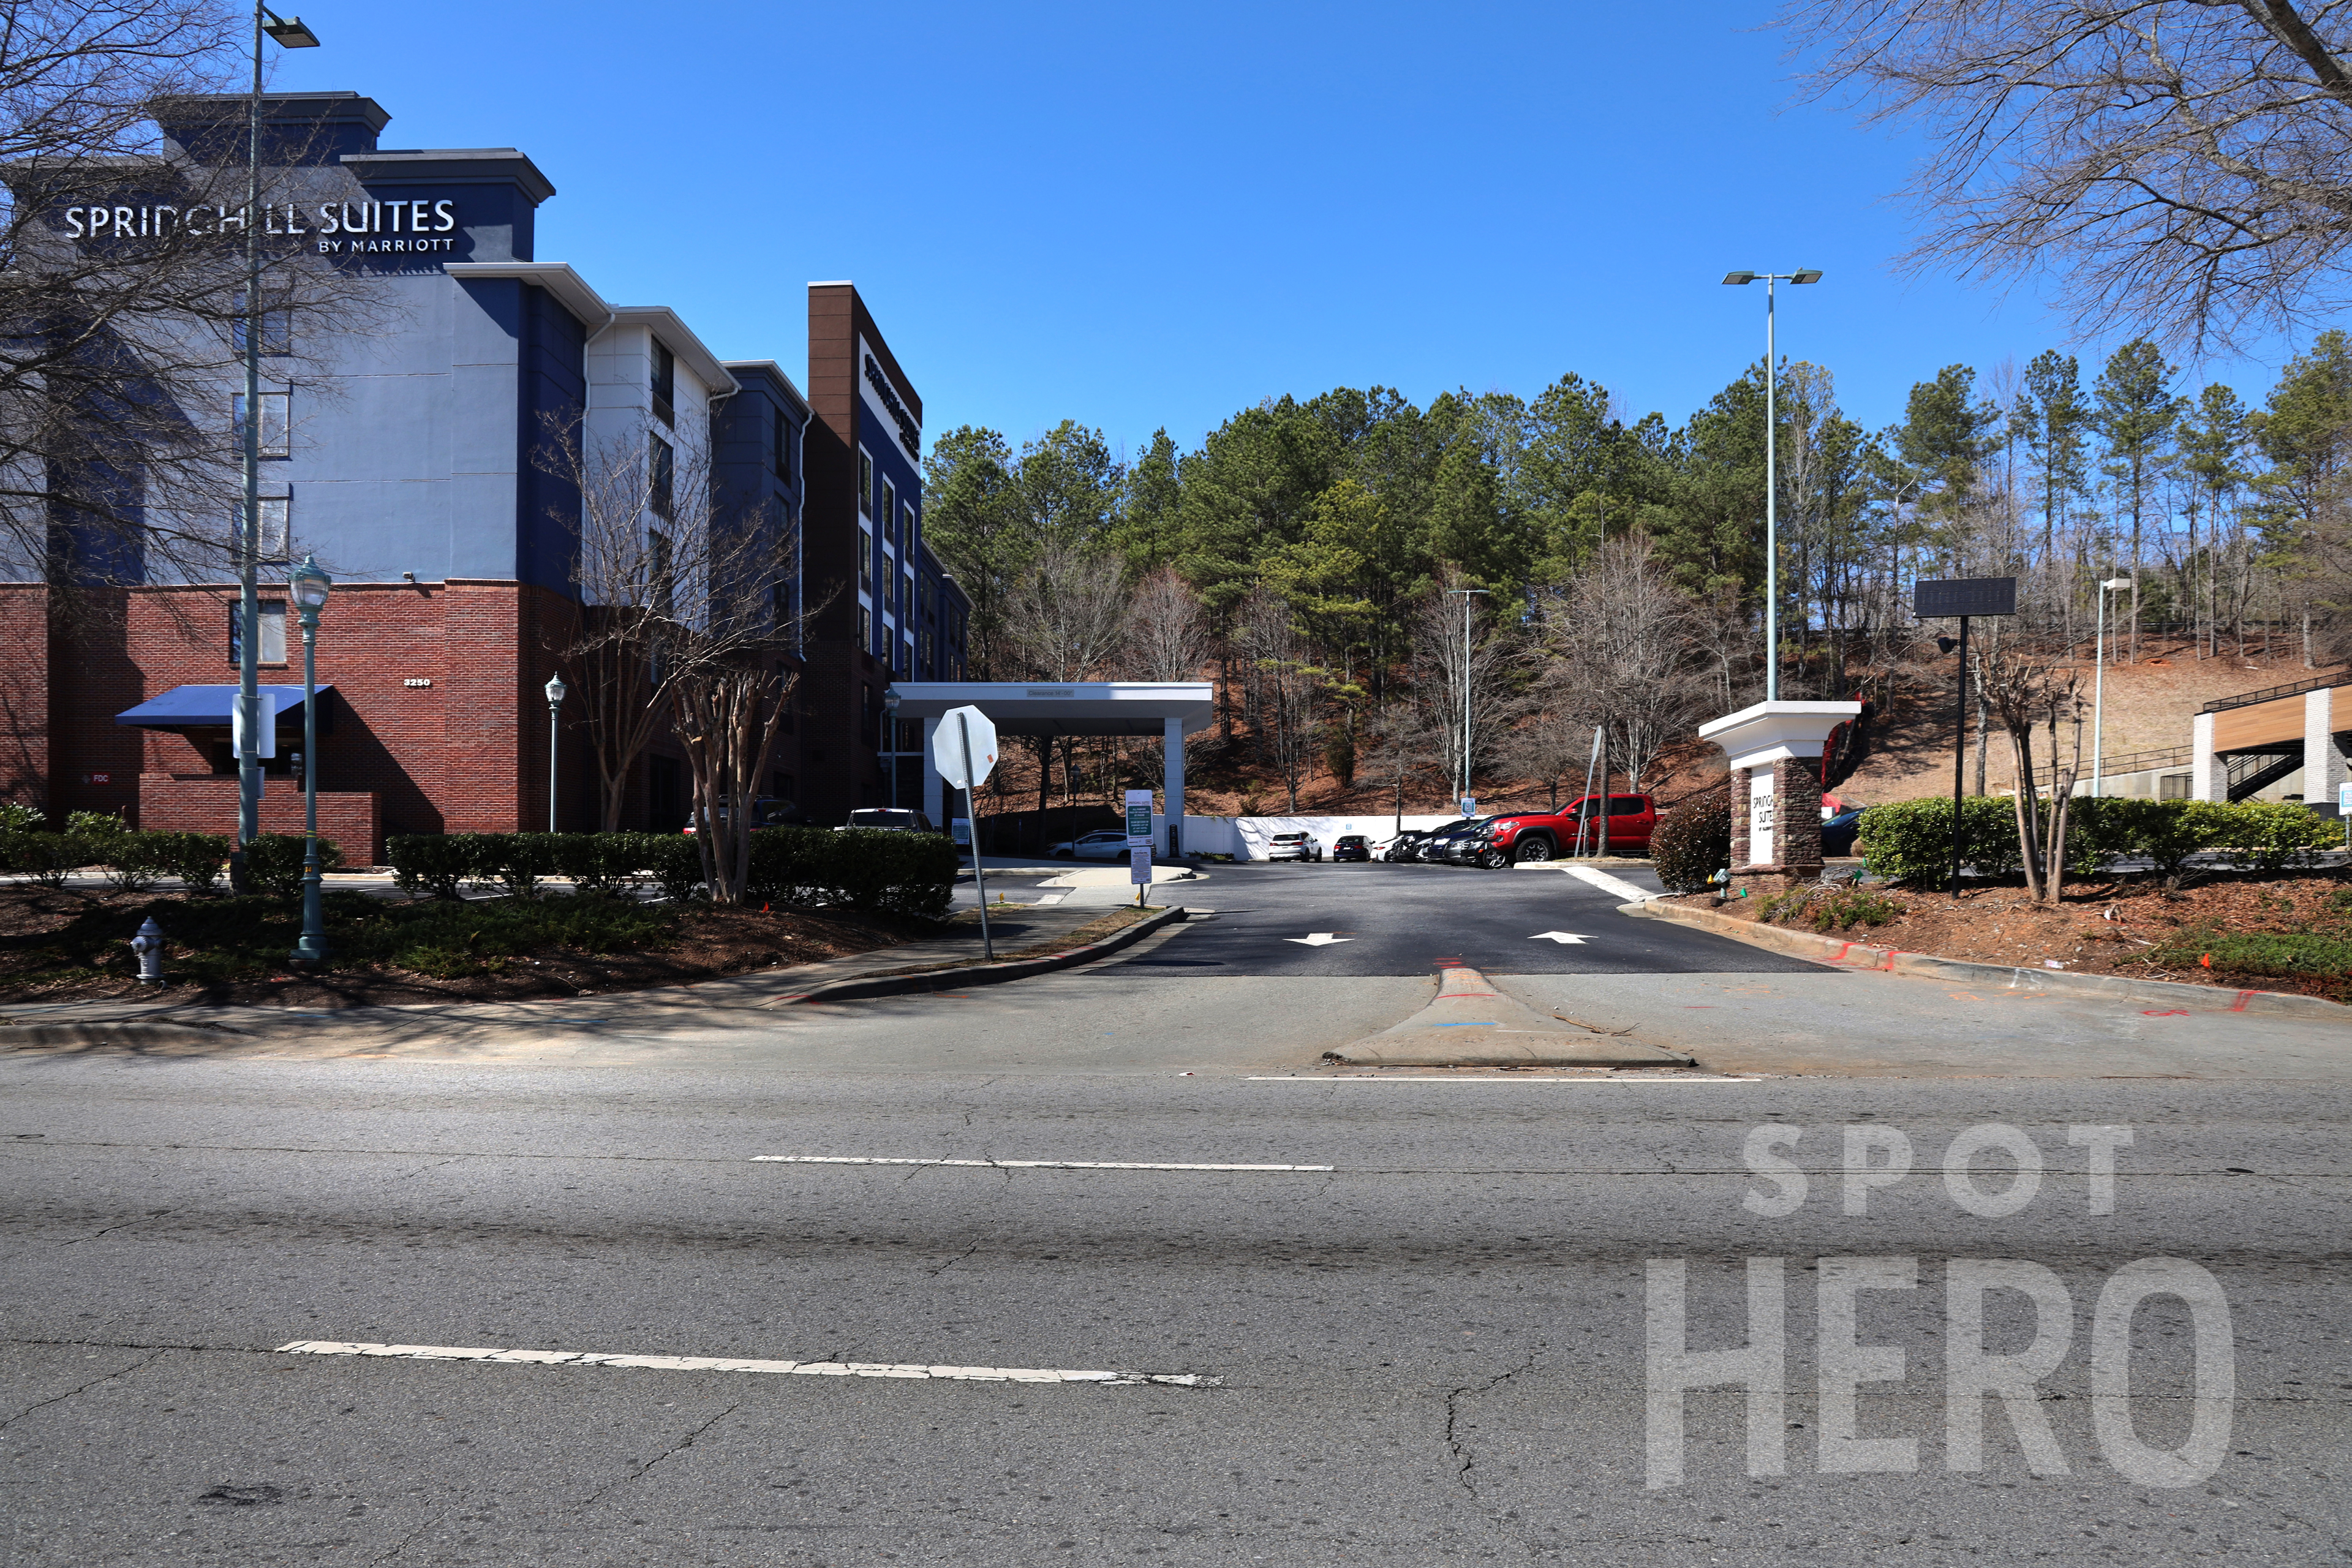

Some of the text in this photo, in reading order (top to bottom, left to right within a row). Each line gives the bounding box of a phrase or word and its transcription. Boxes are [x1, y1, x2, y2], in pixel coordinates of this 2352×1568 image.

[65, 200, 454, 238] SPRINGHLL SUITES
[319, 239, 453, 252] BY MARRIOTT
